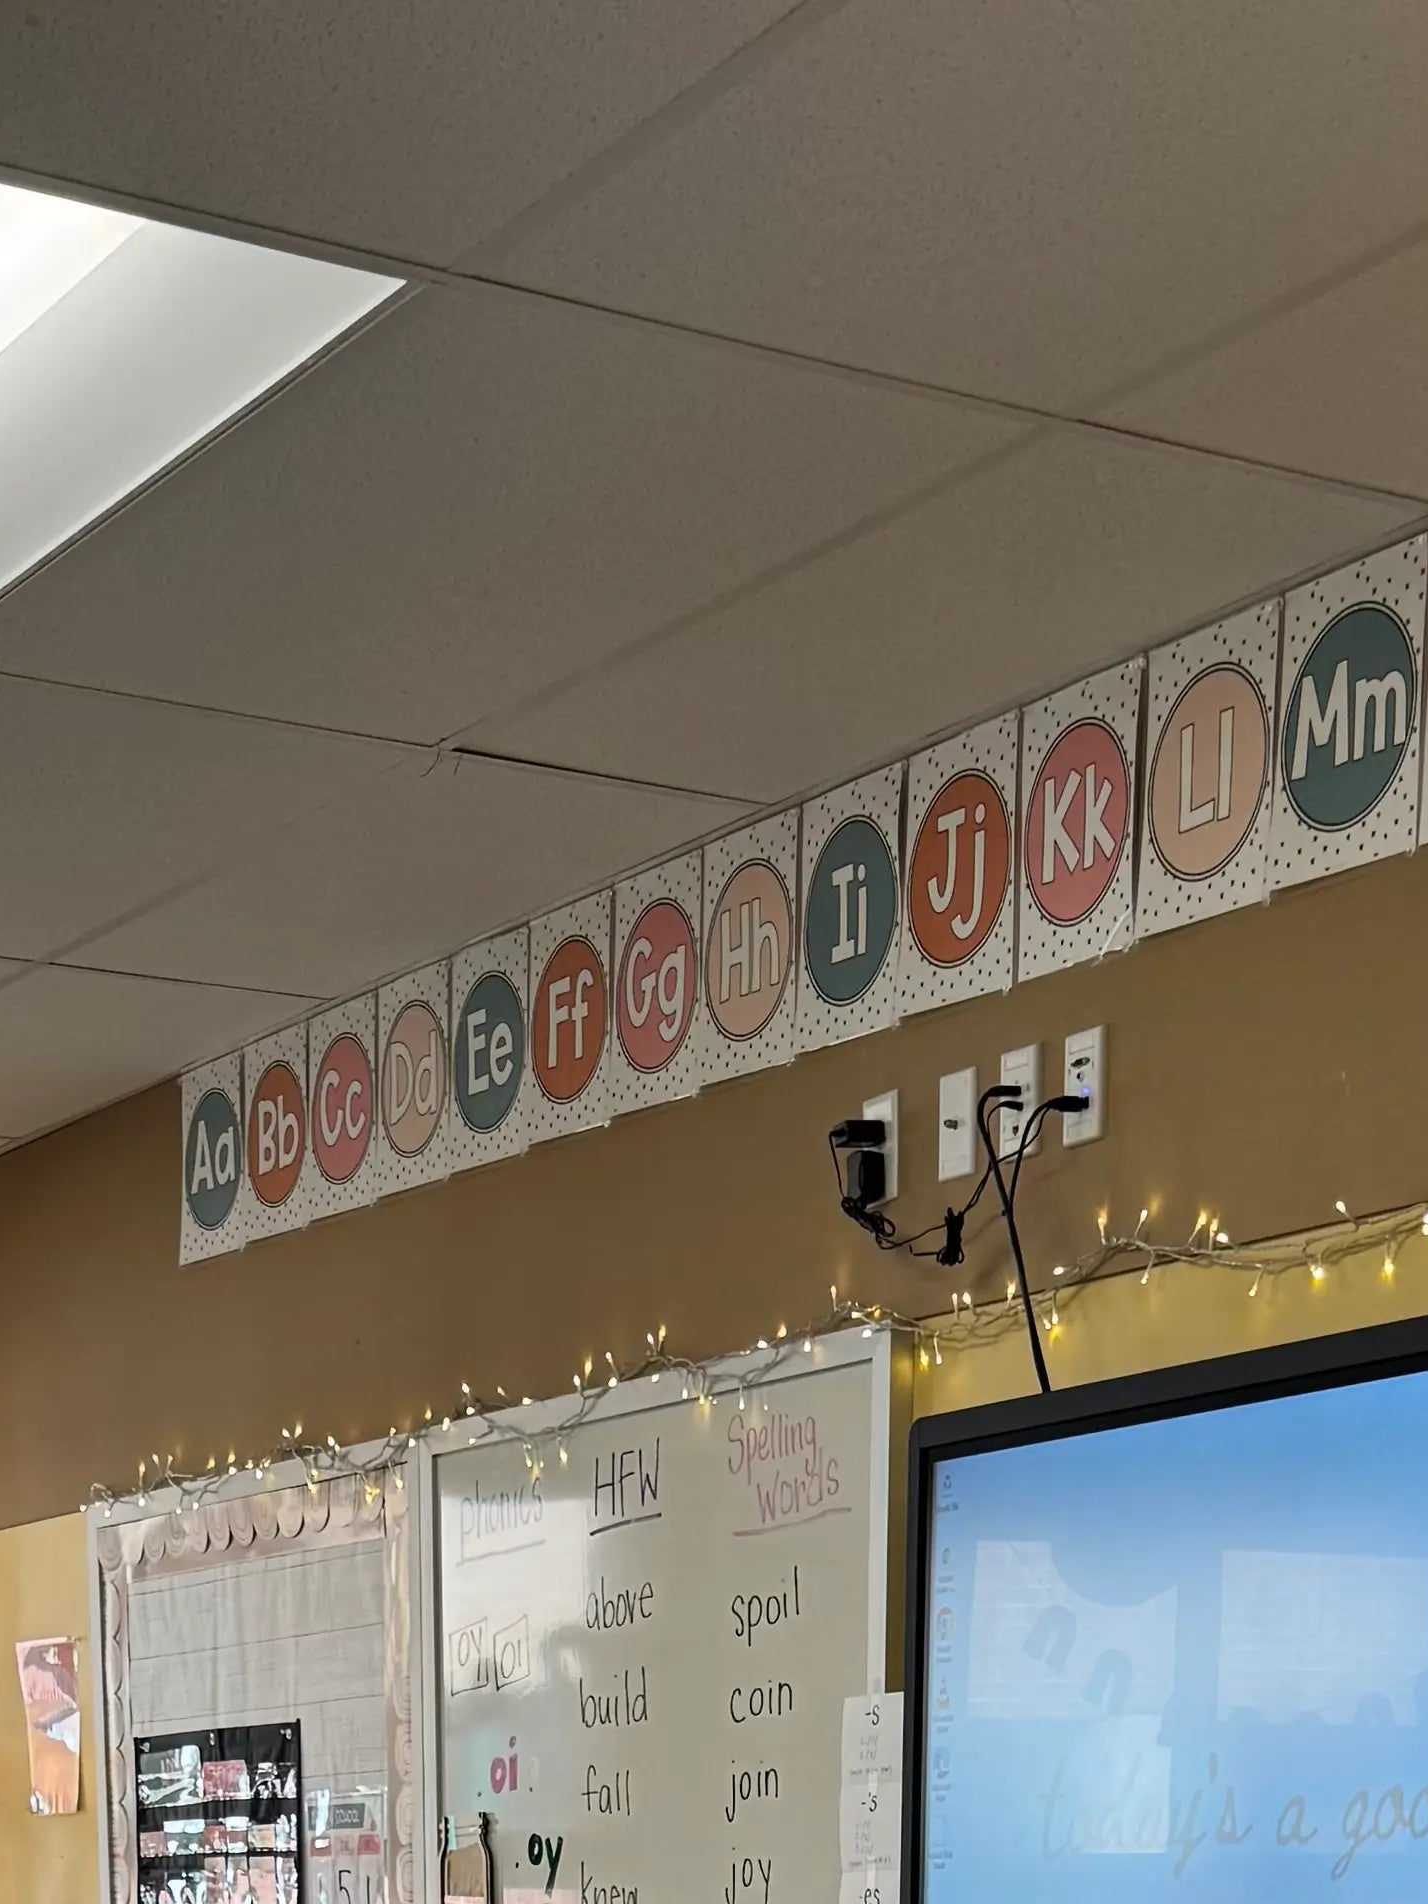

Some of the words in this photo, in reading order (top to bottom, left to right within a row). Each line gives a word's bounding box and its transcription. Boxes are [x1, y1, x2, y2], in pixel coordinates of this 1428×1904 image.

[191, 1120, 235, 1195] Aa
[258, 1098, 298, 1169] Bb
[320, 1068, 366, 1136] Cc
[389, 1031, 437, 1127] Dd
[466, 1010, 513, 1097] Ee
[547, 976, 594, 1071] Ff
[626, 938, 685, 1044] Gg
[718, 907, 782, 1002] Hh
[832, 862, 868, 965] Ii
[928, 804, 985, 940] Jj
[1041, 763, 1116, 885] Kk
[1179, 707, 1235, 834] Ll
[1291, 660, 1407, 782] Mm
[727, 1412, 817, 1476] Spelling
[593, 1437, 661, 1518] HFW
[586, 1575, 655, 1630] above
[730, 1564, 801, 1647] spoil
[579, 1665, 649, 1729] build
[730, 1679, 793, 1725] coin
[581, 1765, 631, 1816] fall
[726, 1760, 779, 1823] join
[1276, 1795, 1317, 1846] a
